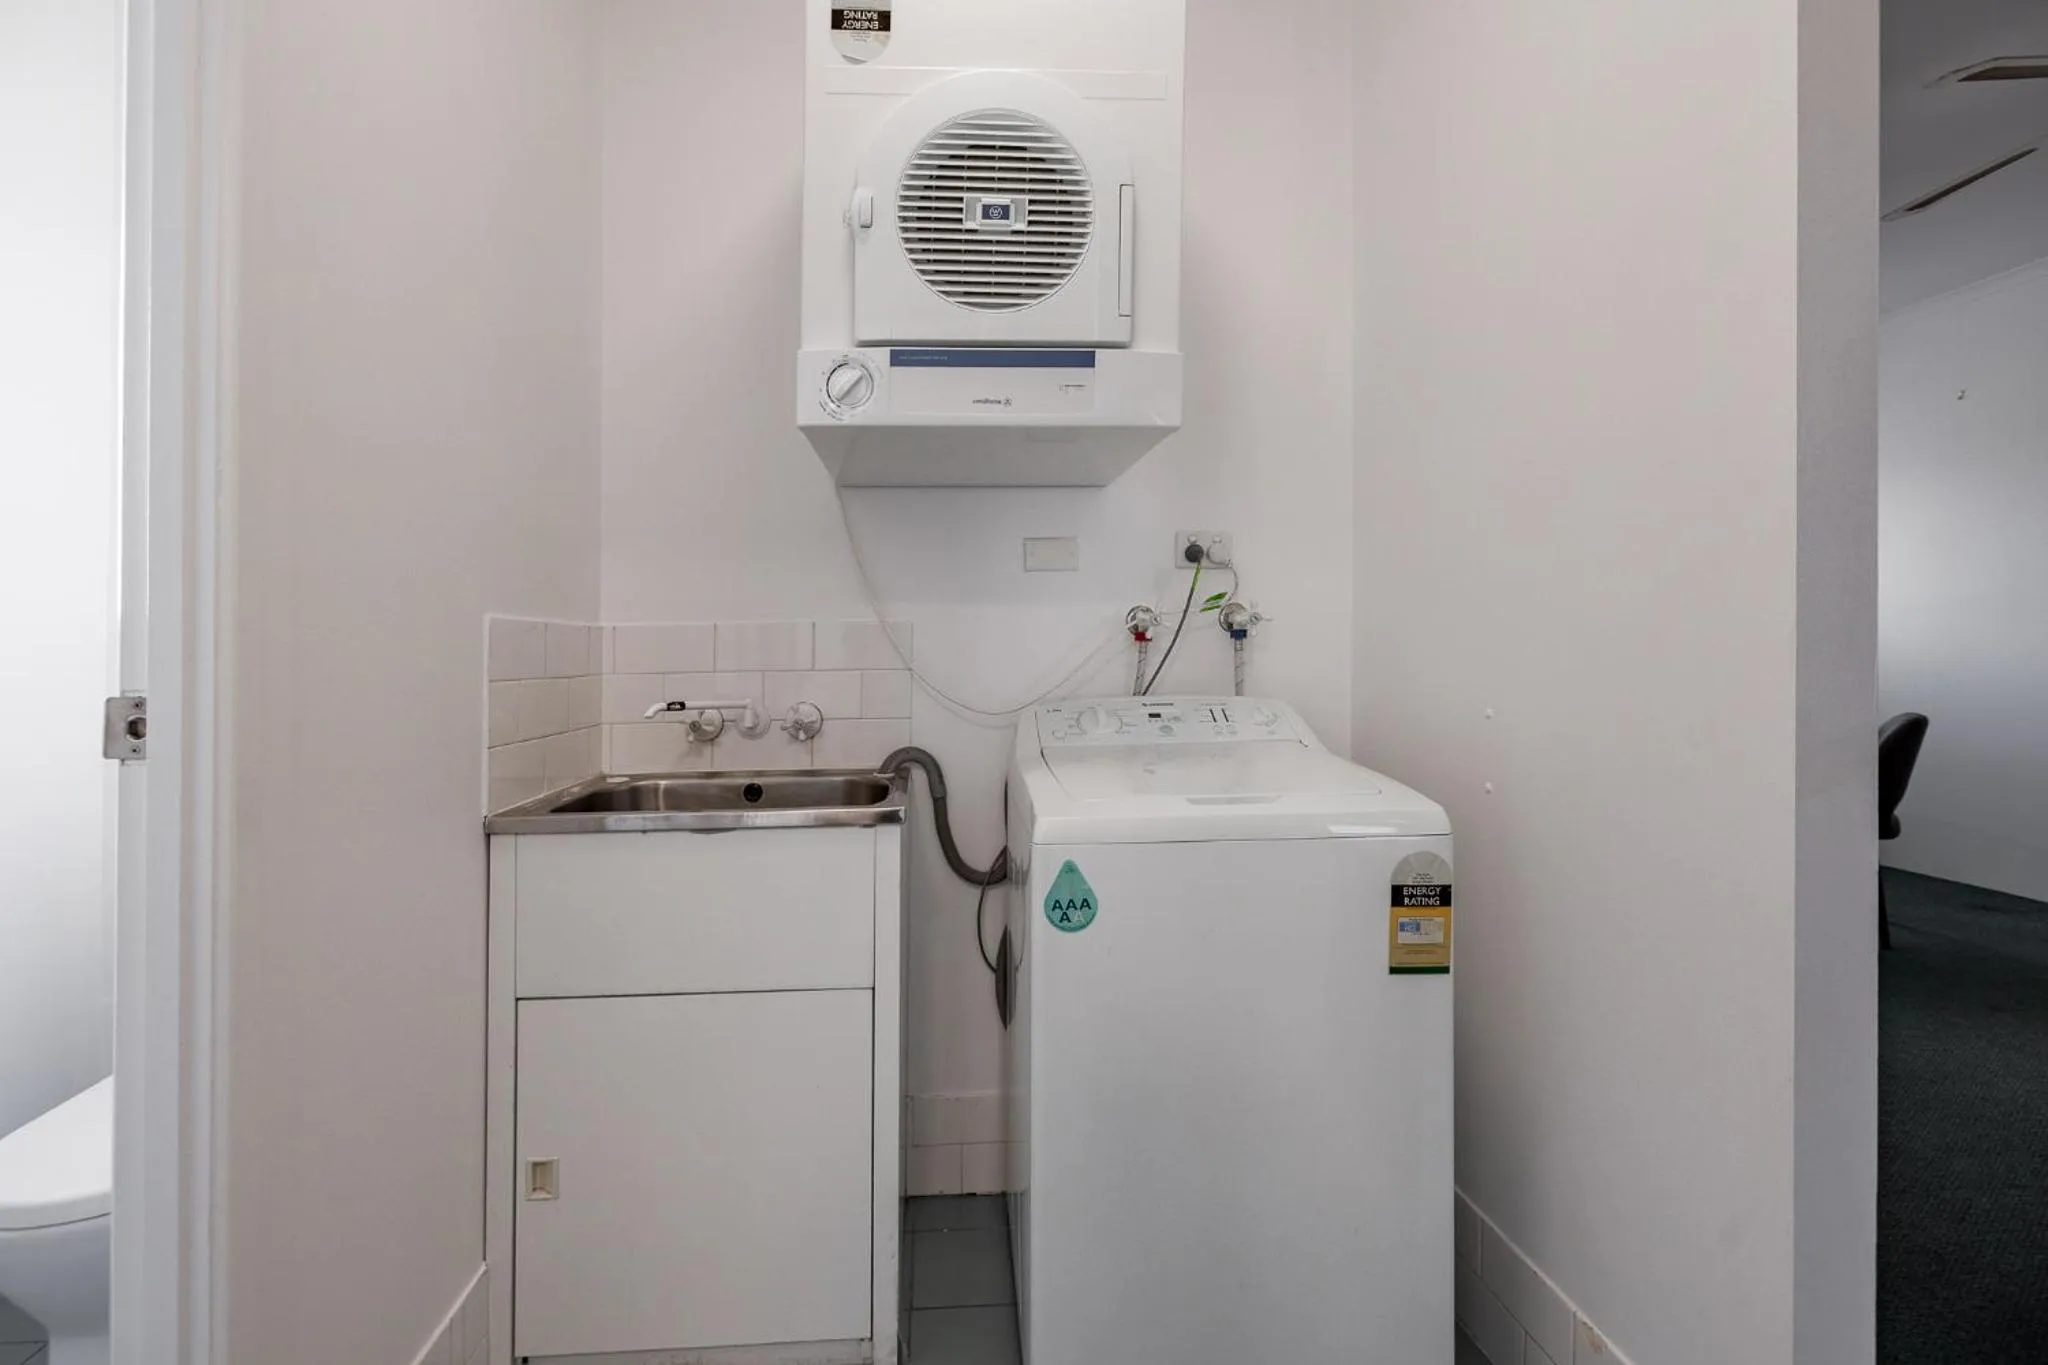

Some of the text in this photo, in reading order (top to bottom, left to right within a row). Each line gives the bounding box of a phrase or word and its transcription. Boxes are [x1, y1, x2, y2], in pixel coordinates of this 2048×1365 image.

[843, 10, 879, 20] RATING
[841, 20, 879, 30] ENERGY
[1403, 886, 1442, 896] ENERGY
[1404, 897, 1440, 906] RATING
